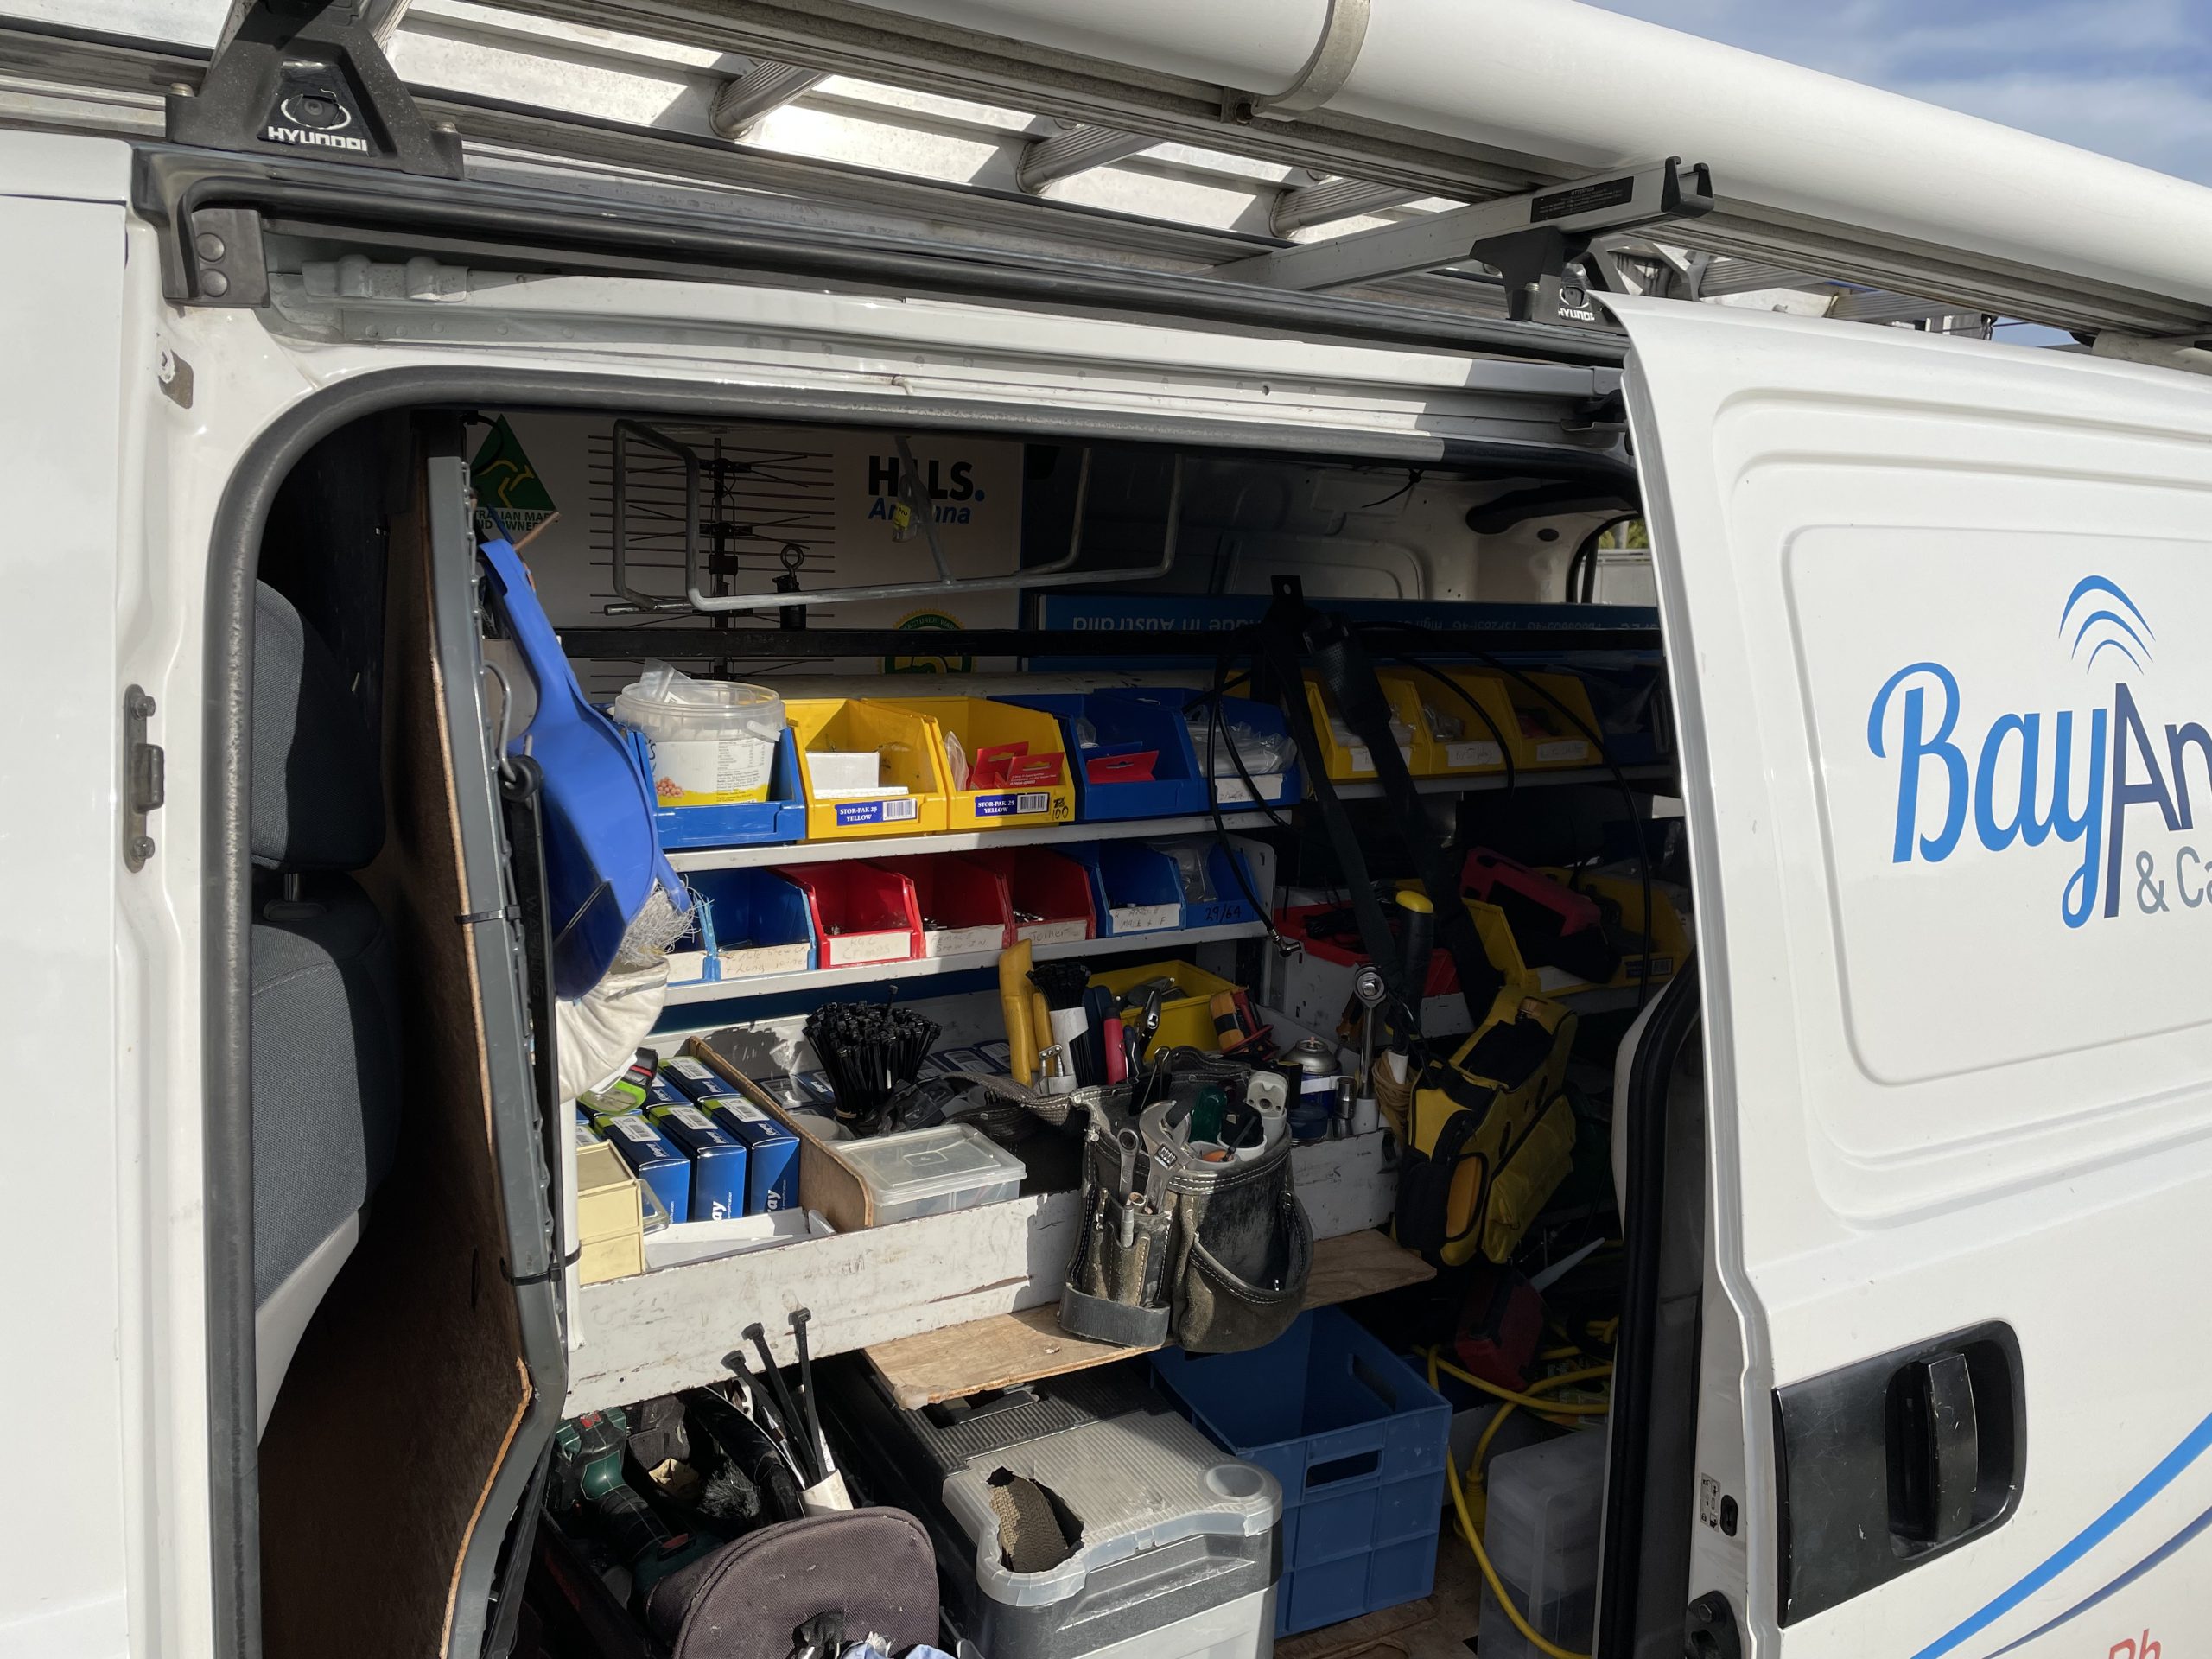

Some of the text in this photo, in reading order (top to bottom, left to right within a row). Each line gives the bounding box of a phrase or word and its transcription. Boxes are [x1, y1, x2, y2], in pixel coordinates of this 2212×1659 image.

[267, 126, 368, 152] HYUNDAI
[2136, 850, 2170, 914] &
[1205, 903, 1242, 924] 29/64
